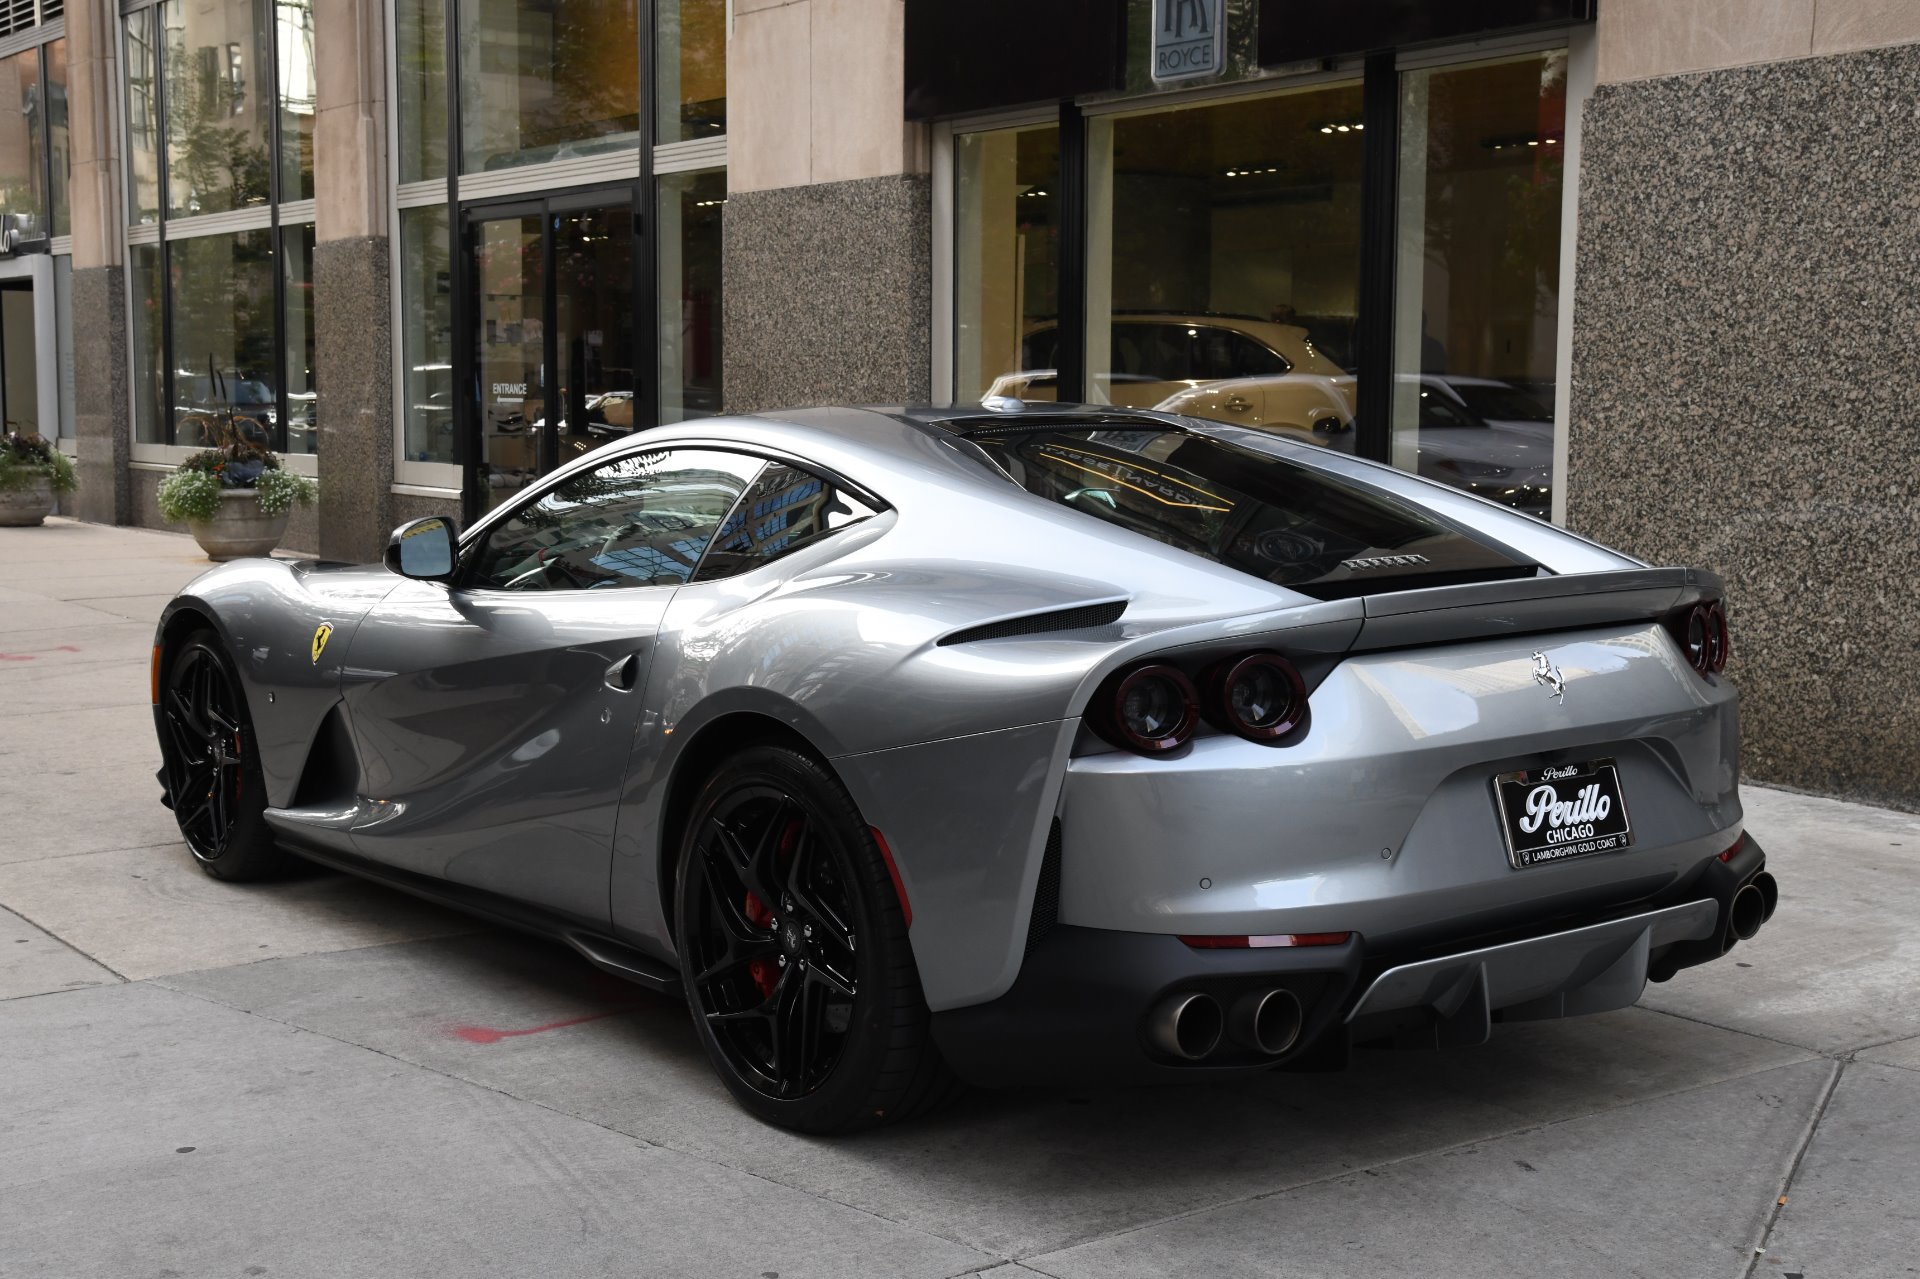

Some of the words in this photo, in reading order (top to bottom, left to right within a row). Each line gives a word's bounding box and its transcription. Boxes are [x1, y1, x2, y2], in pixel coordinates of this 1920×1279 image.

[1159, 45, 1210, 70] ROYCE
[492, 383, 527, 395] ENTRANCE
[1541, 765, 1577, 781] Perillo
[1519, 784, 1610, 833] Perillo
[1546, 823, 1594, 844] CHICAGO
[1532, 845, 1577, 861] LAMBORGHINI
[1577, 841, 1595, 853] GOLD
[1596, 837, 1617, 849] COAST
